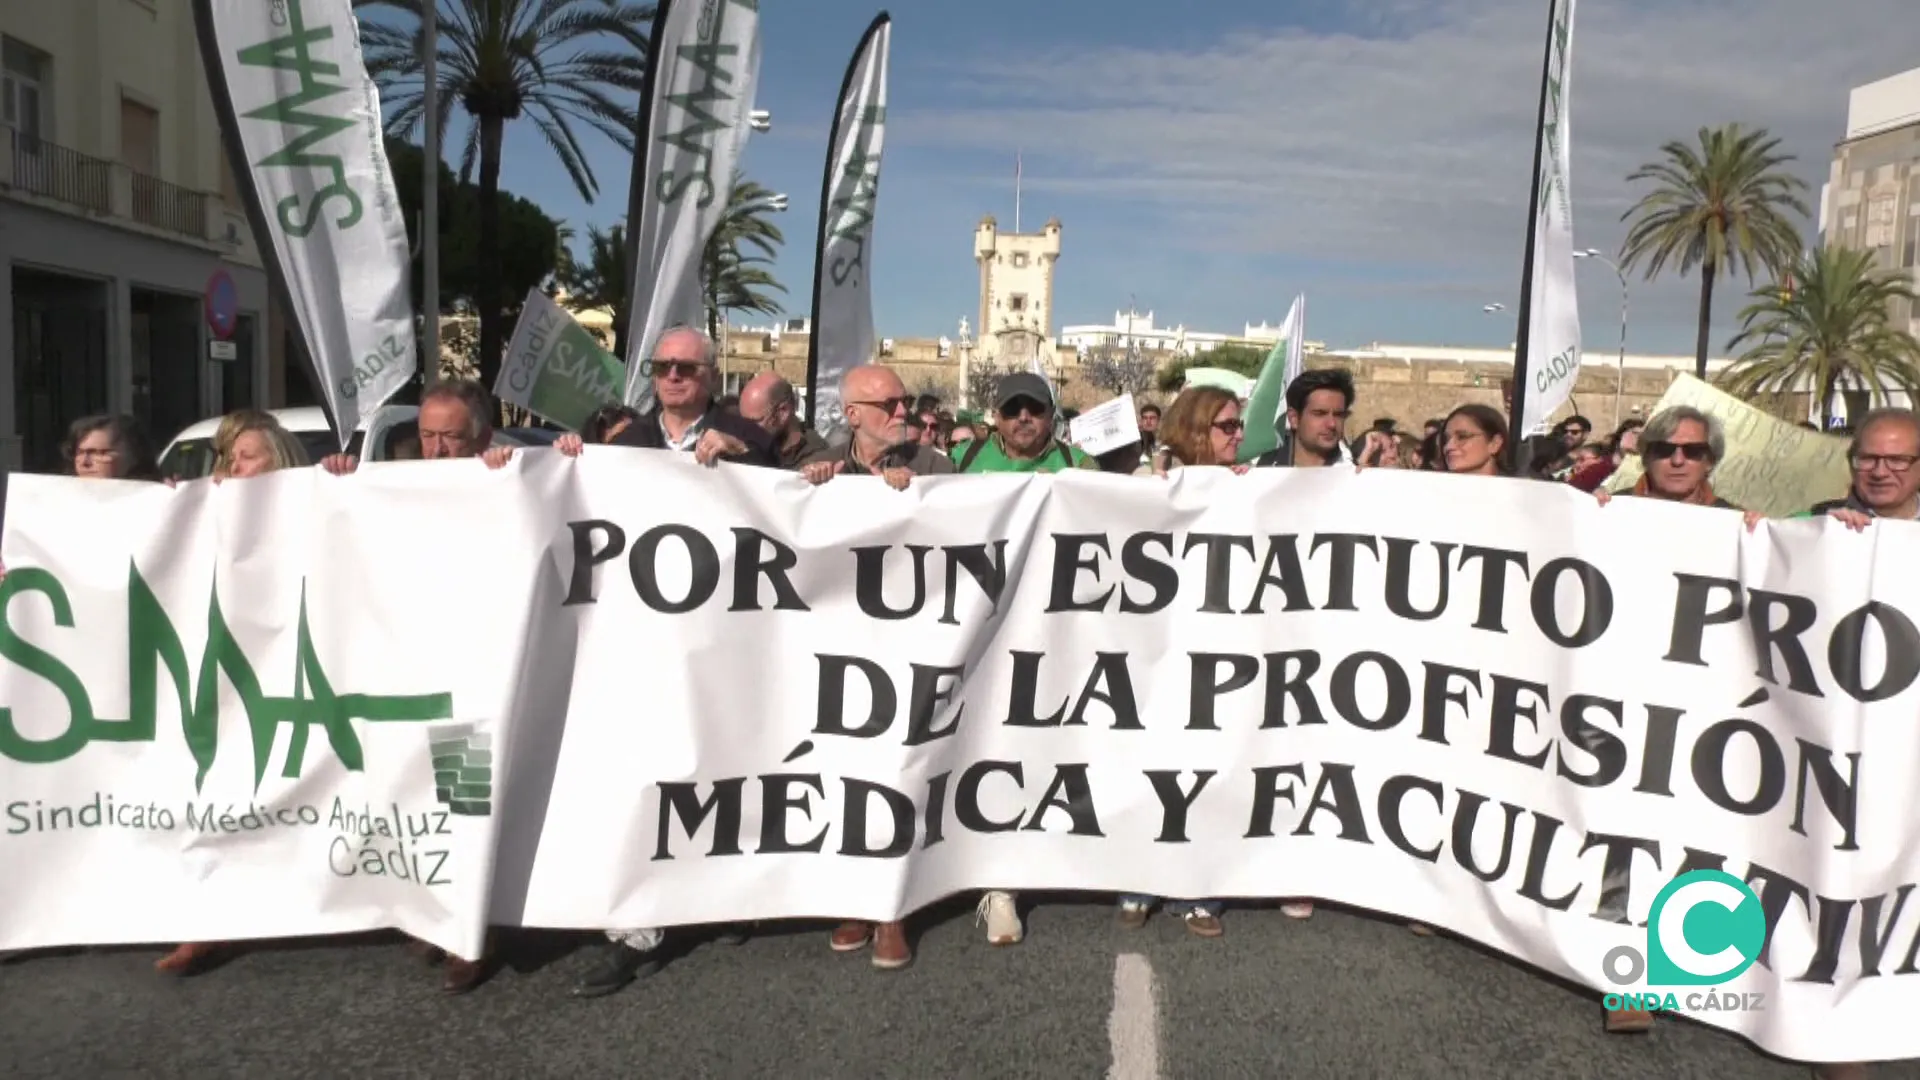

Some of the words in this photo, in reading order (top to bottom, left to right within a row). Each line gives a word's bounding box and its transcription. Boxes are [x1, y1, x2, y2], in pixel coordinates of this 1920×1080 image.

[562, 519, 811, 614] POR
[849, 538, 1010, 626] UN
[1043, 531, 1613, 649] ESTATUTO
[1661, 571, 1920, 703] PRO
[6, 793, 176, 835] Sindicato
[186, 803, 319, 834] Médico
[328, 796, 452, 840] Andaluz
[811, 652, 966, 747] DE
[1002, 648, 1146, 731] LA
[1184, 648, 1861, 852] PROFESIÓN
[328, 832, 452, 886] Cádiz
[650, 739, 1107, 861] MÉDICA
[1142, 768, 1218, 844] Y
[1242, 760, 1920, 986] FACULTTIV
